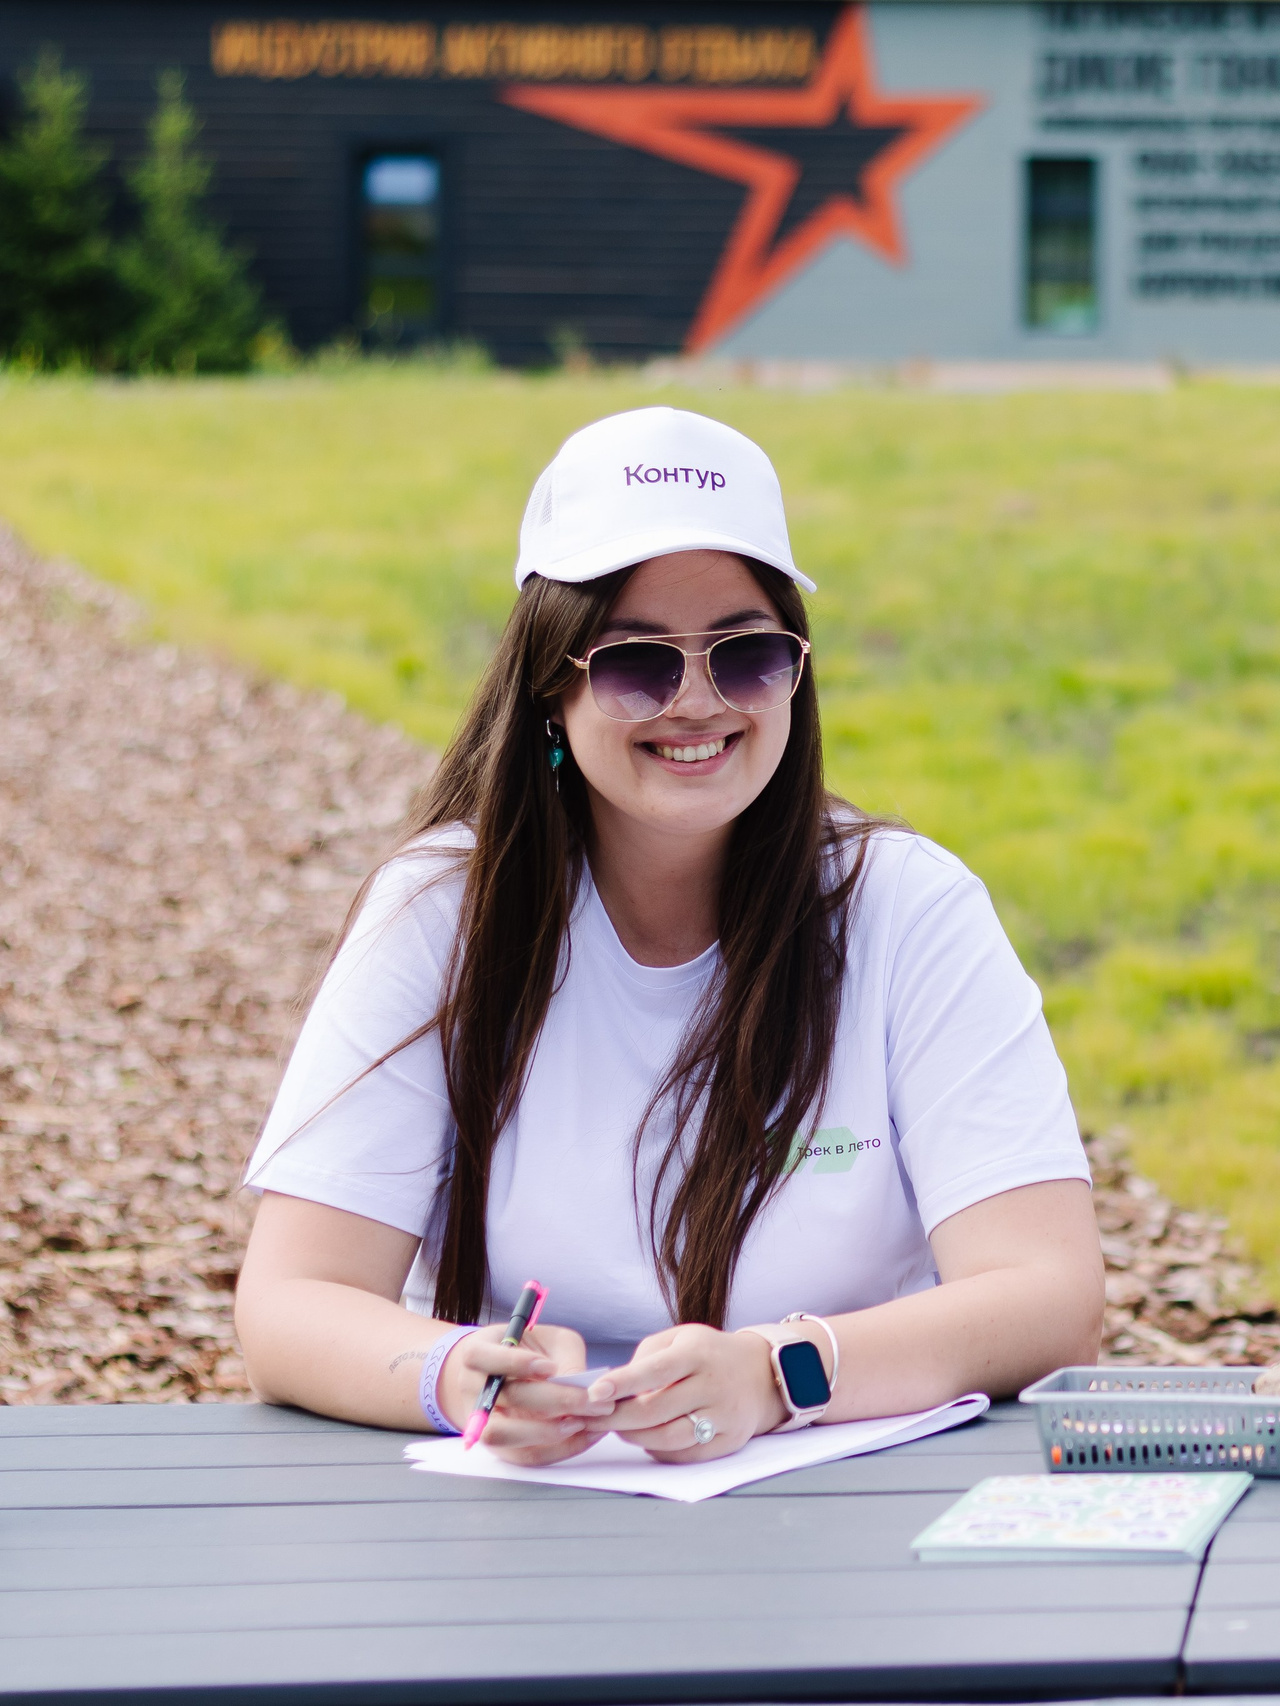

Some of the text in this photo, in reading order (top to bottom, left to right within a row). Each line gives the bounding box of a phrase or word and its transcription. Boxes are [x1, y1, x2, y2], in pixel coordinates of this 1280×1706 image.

[623, 463, 726, 491] Контур
[835, 1144, 844, 1154] в
[848, 1138, 881, 1153] лето
